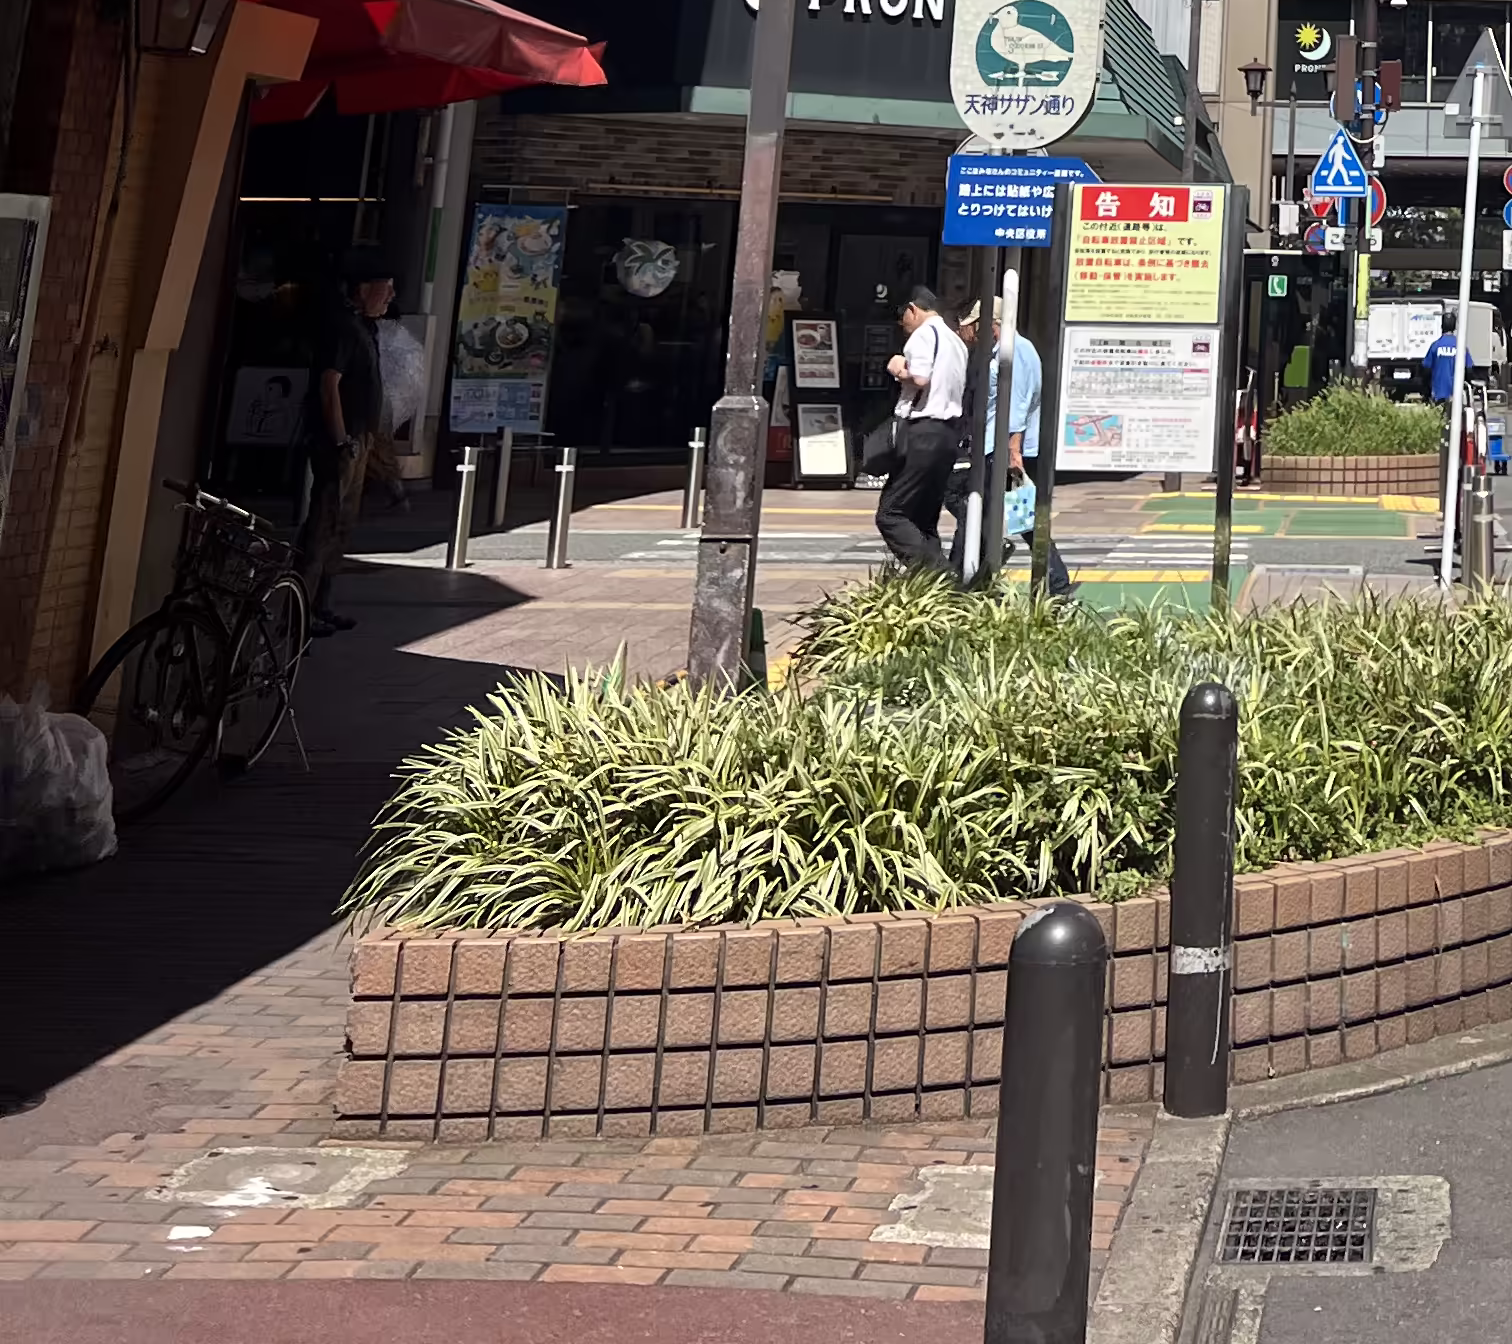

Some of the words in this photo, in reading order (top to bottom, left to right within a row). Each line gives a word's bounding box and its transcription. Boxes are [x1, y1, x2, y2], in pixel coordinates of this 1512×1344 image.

[1294, 63, 1327, 73] PRON
[963, 93, 1076, 116] 天神サザン通り
